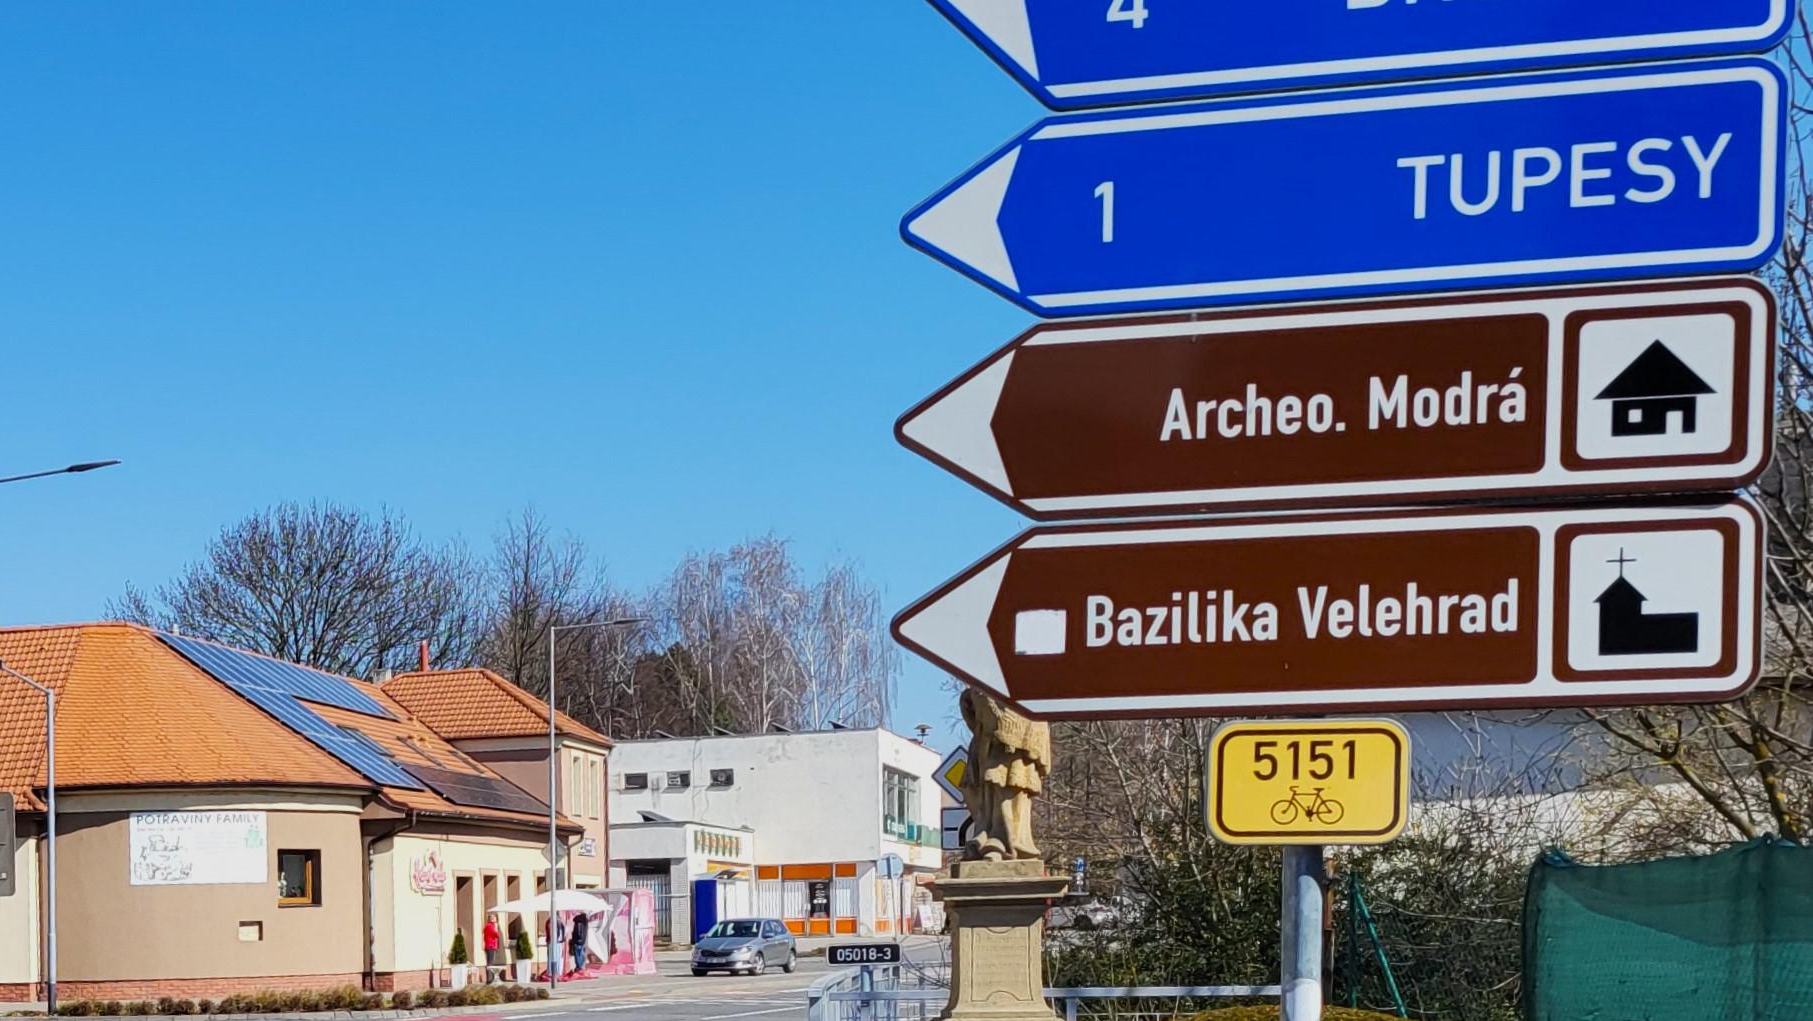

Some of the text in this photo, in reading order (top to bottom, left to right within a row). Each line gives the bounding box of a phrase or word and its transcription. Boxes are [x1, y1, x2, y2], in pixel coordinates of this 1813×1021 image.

[1094, 132, 1733, 243] 1 TUPESY
[1158, 366, 1528, 443] Archeo. Modrá
[1085, 576, 1520, 649] Bazilika Velehrad
[1252, 739, 1357, 781] 5151
[136, 813, 260, 825] POTRAVINY FAMILY
[836, 947, 892, 961] 05018-3
